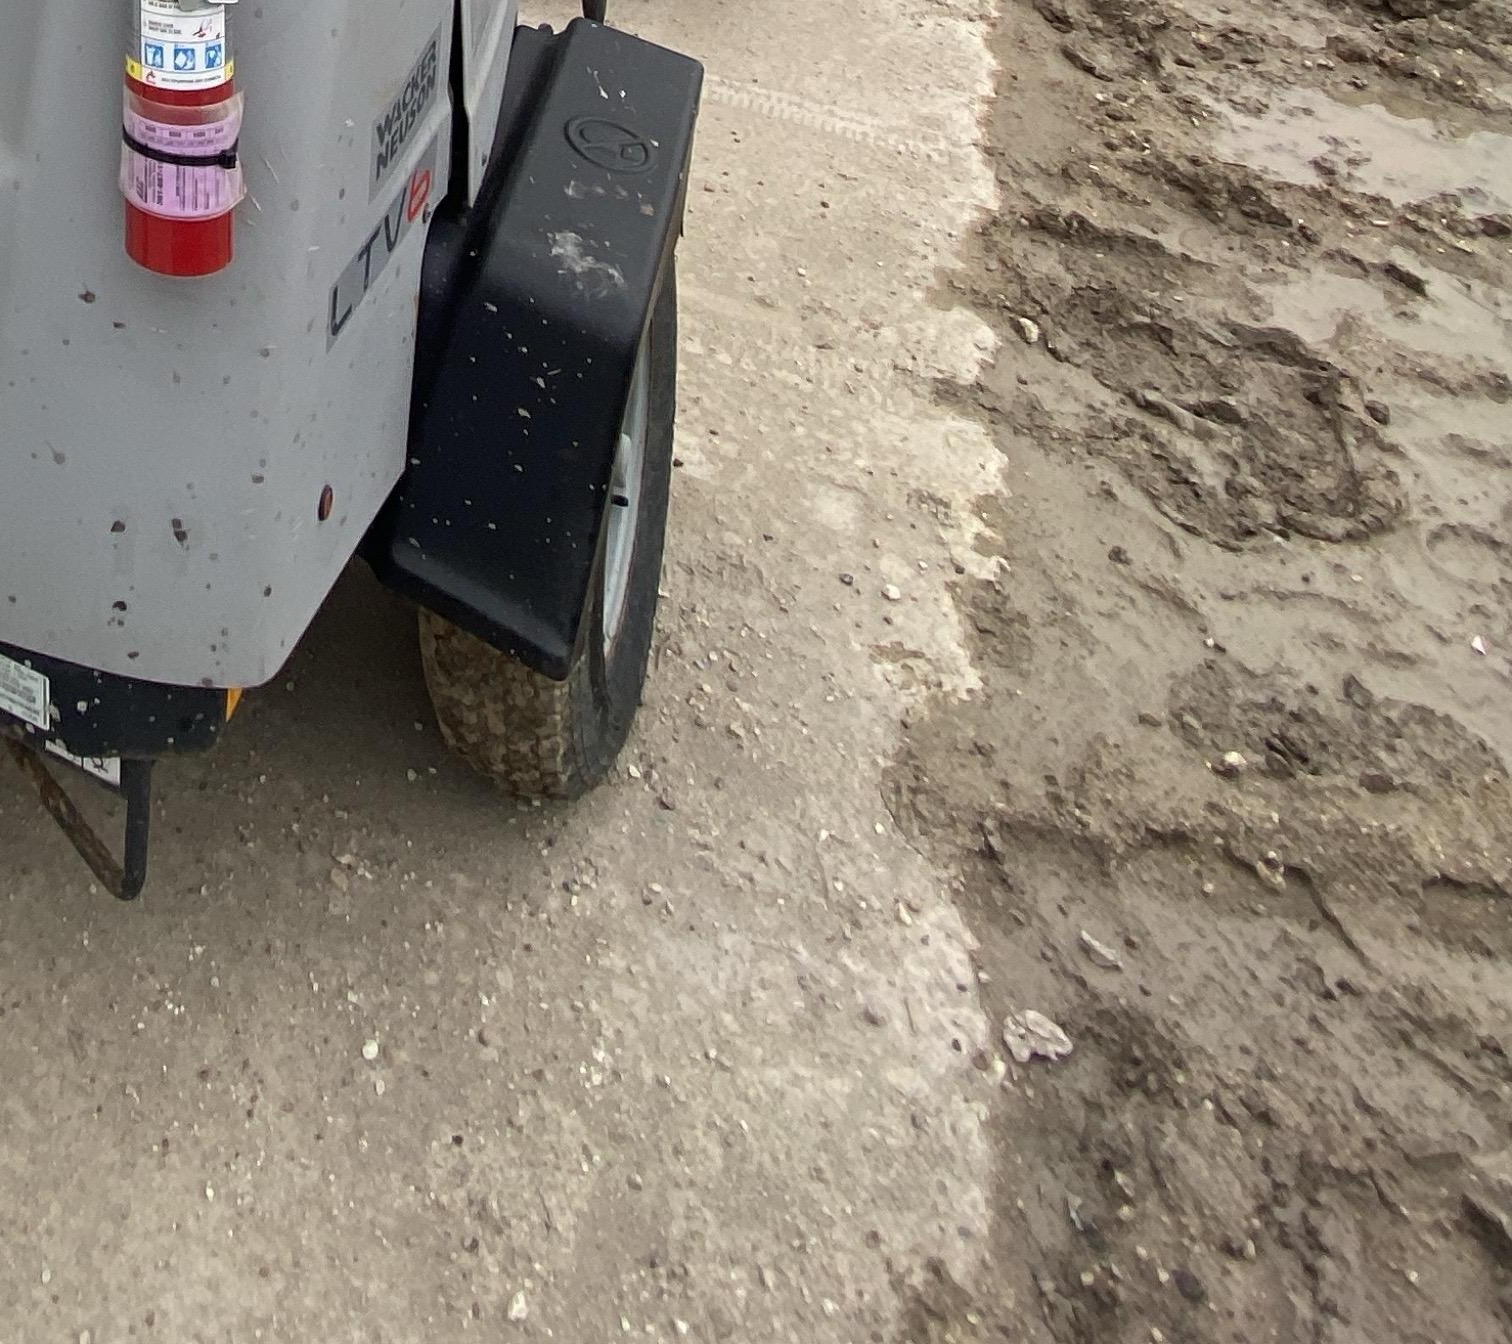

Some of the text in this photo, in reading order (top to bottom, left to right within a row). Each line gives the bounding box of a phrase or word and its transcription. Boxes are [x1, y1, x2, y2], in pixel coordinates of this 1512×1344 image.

[376, 40, 437, 146] WACKER
[376, 66, 437, 181] NEUSON
[331, 168, 432, 337] LTV6
